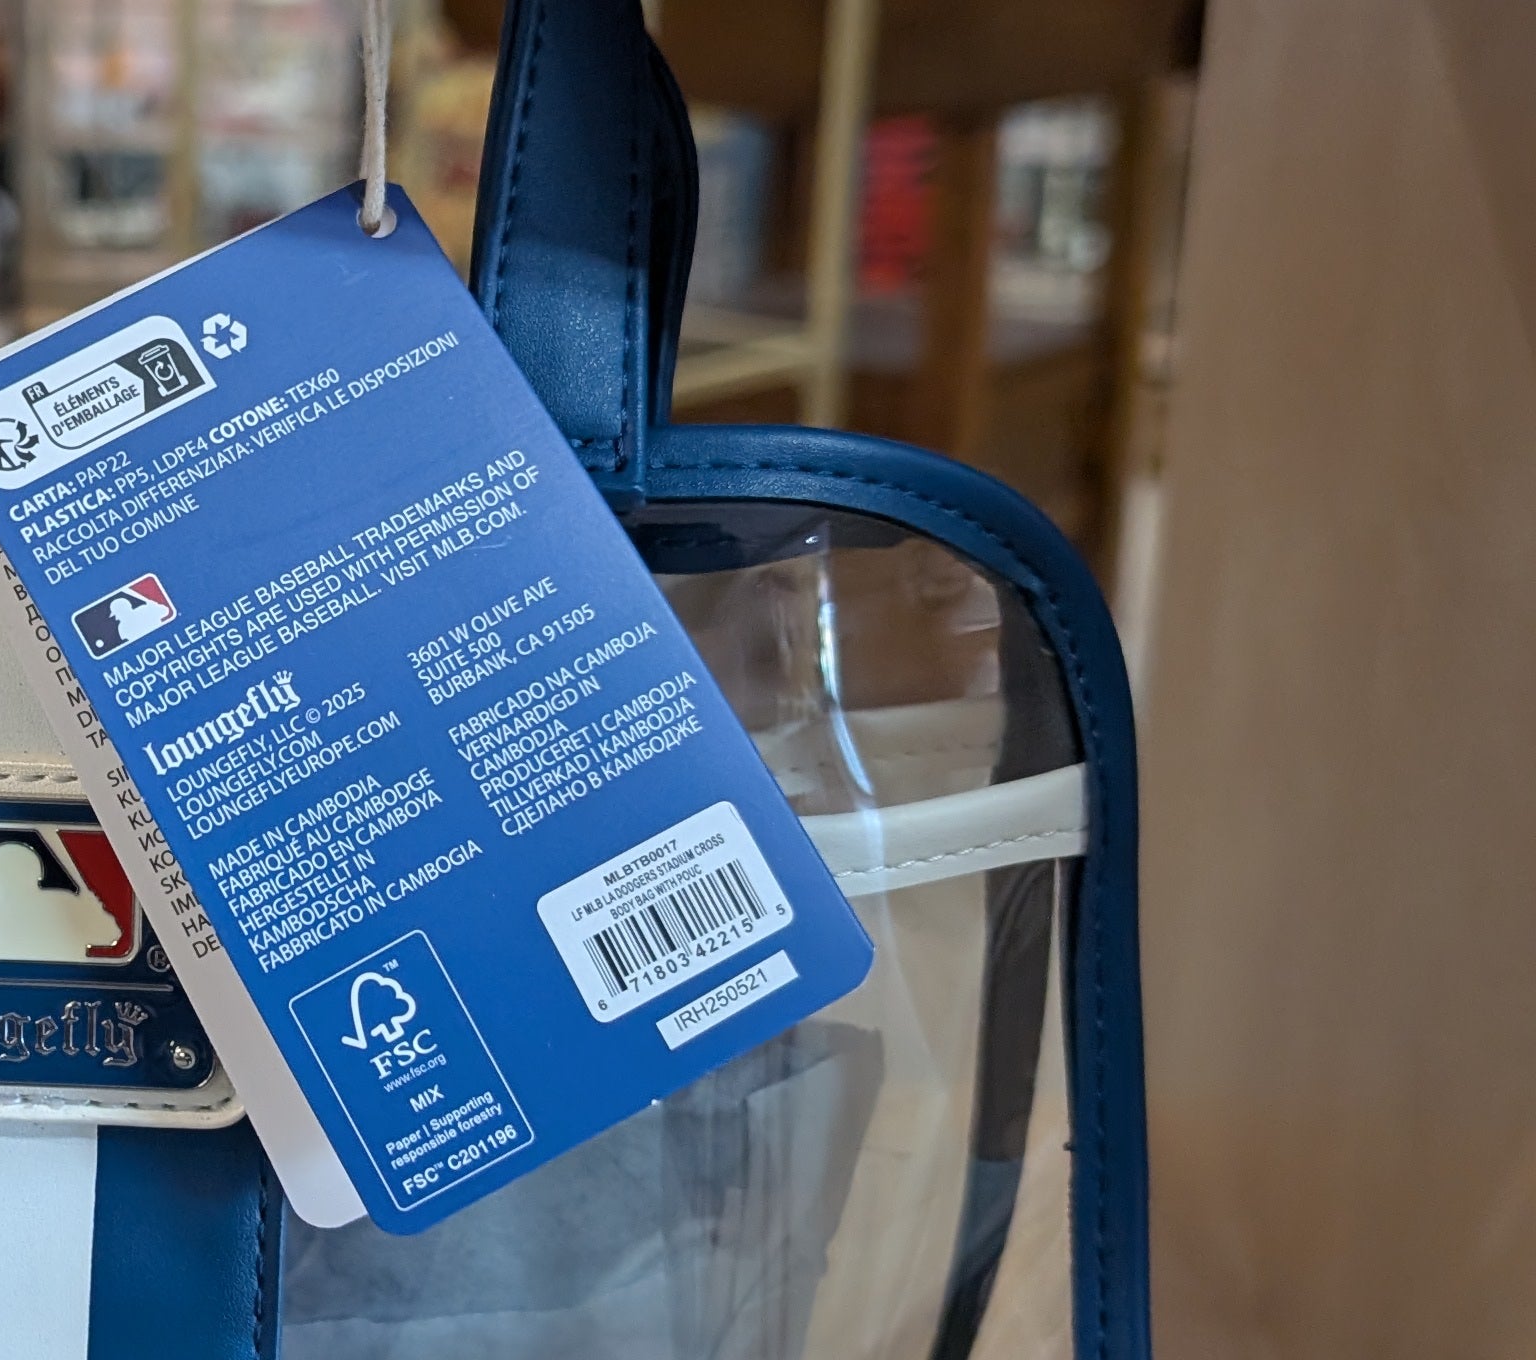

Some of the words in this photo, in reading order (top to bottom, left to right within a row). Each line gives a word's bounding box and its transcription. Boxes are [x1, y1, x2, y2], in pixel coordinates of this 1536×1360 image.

[26, 381, 45, 401] FR
[50, 384, 141, 438] D'EMBALLAGE
[53, 376, 120, 418] ÉLÉMENTS
[9, 481, 77, 522] CARTA:
[74, 451, 132, 488] PAP22
[20, 487, 117, 544] PLASTICA:
[114, 466, 155, 494] PP5,
[152, 436, 209, 474] LDPE4
[208, 396, 289, 444] COTONE:
[284, 368, 340, 403] TEX60
[32, 508, 123, 564] RACCOLTA
[121, 442, 254, 517] DIFFERENZIATA:
[249, 401, 328, 448] VERIFICA
[325, 388, 350, 410] LE
[347, 331, 459, 399] DISPOSIZIONI
[44, 558, 83, 585] DEL
[78, 536, 120, 565] TUO
[120, 493, 200, 544] COMUNE
[102, 640, 175, 689] MAJOR
[173, 595, 256, 650] LEAGUE
[254, 544, 355, 606] BASEBALL
[351, 472, 484, 550] TRADEMARKS
[486, 450, 526, 482] AND
[115, 628, 243, 707] COPYRIGHTS
[246, 603, 288, 638] ARE
[286, 574, 342, 613] USED
[341, 545, 395, 582] WITH
[394, 481, 513, 555] PERMISSION
[513, 465, 539, 490] OF
[125, 679, 197, 729] MAJOR
[196, 634, 278, 689] LEAGUE
[277, 583, 382, 645] BASEBALL.
[380, 549, 430, 586] VISIT
[431, 501, 527, 560] MLB.COM.
[407, 636, 450, 669] 3601
[448, 623, 469, 644] W
[470, 595, 523, 633] OLIVE
[523, 576, 557, 607] AVE
[417, 648, 469, 687] SUITE
[467, 631, 502, 660] 500
[427, 648, 517, 705] BURBANK,
[515, 633, 544, 656] CA
[541, 603, 595, 642] 91505
[448, 682, 546, 745] FABRICADO
[544, 667, 576, 691] NA
[573, 621, 658, 675] CAMBOJA
[143, 670, 301, 775] loungefly
[166, 734, 273, 803] LOUNGEFLY,
[270, 715, 306, 745] LLC
[321, 682, 366, 717] 2025
[457, 688, 579, 762] VERVAARDIGD
[577, 675, 601, 697] IN
[470, 718, 569, 781] CAMBODJA
[479, 726, 592, 801] PRODUCERET
[601, 671, 697, 732] CAMBODJA
[488, 753, 591, 818] TILLVERKAD
[597, 696, 696, 758] KAMBODJA
[176, 730, 323, 821] LOUNGEFLY.COM
[186, 710, 401, 840] LOUNGEFLYEUROPE.COM
[501, 779, 588, 836] СДЕЛАНО
[586, 771, 603, 789] В
[600, 714, 704, 781] КАМБОДЖЕ
[208, 838, 265, 880] MADE
[262, 826, 285, 850] IN
[284, 774, 382, 841] CAMBODIA
[217, 837, 306, 899] FABRIQUÉ
[306, 823, 332, 851] AU
[332, 767, 435, 834] CAMBODGE
[228, 851, 328, 917] FABRICADO
[327, 835, 356, 861] EN
[355, 789, 443, 846] CAMBOYA
[602, 838, 677, 887] MLBTB0017
[238, 860, 352, 936] HERGESTELLT
[352, 849, 376, 872] IN
[248, 874, 376, 955] KAMBODSCHA
[258, 904, 364, 973] FABBRICATO
[363, 891, 387, 915] IN
[385, 839, 483, 901] CAMBOGIA
[570, 906, 583, 922] LF
[582, 897, 604, 916] MLB
[601, 892, 617, 906] LA
[613, 869, 658, 900] DODGERS
[656, 848, 696, 877] STADIUM
[693, 833, 725, 857] CROSS
[609, 898, 636, 920] BODY
[634, 888, 656, 907] BAG
[653, 876, 679, 896] WITH
[675, 863, 702, 885] POUC
[673, 968, 768, 1032] IRH250521
[369, 1028, 437, 1079] FSC
[383, 1053, 447, 1093] www.fsc.org
[409, 1084, 444, 1113] MIX
[385, 1129, 422, 1155] Paper
[429, 1091, 494, 1136] Supporting
[390, 1123, 457, 1170] responsible
[457, 1101, 502, 1133] forestry
[447, 1124, 517, 1171] C201196
